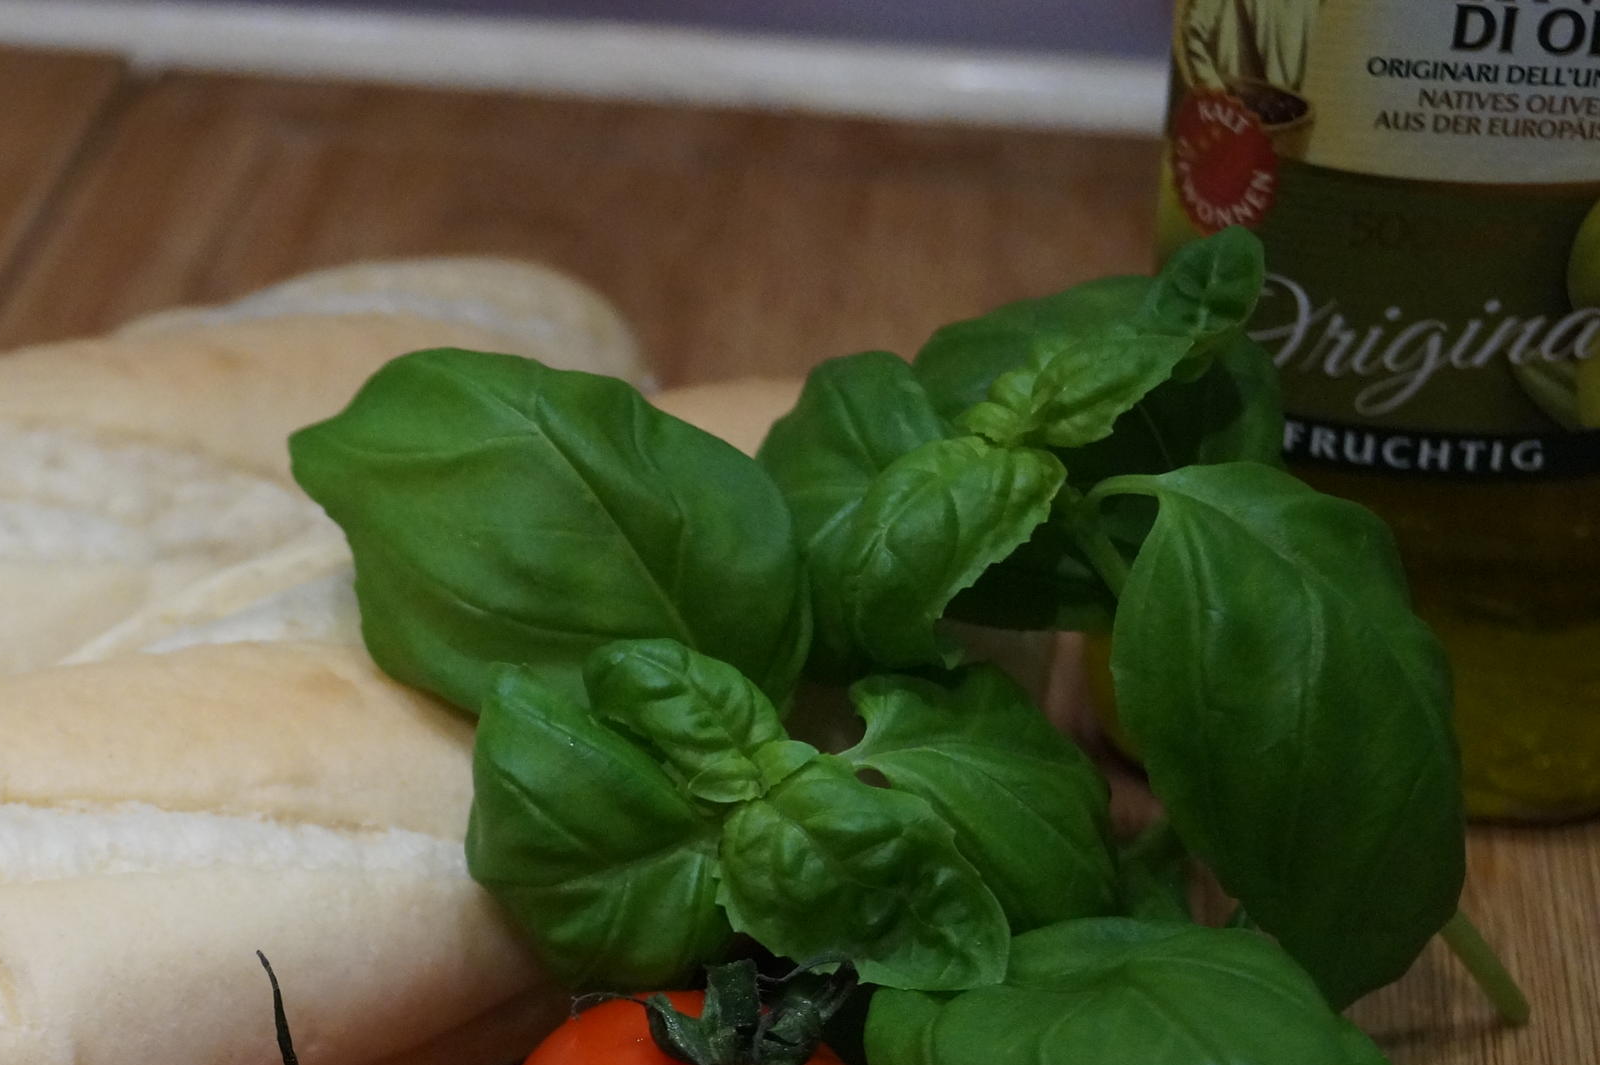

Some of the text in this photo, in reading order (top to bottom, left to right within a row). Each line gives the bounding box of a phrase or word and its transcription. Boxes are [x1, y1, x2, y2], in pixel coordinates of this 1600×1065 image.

[1451, 4, 1520, 53] DI
[1367, 56, 1499, 84] ORIGINARI
[1418, 88, 1520, 112] NATIVES
[1197, 101, 1249, 135] KALT
[1374, 110, 1425, 133] AUS
[1432, 114, 1481, 137] DER
[1282, 420, 1545, 472] FRUCHTIG
